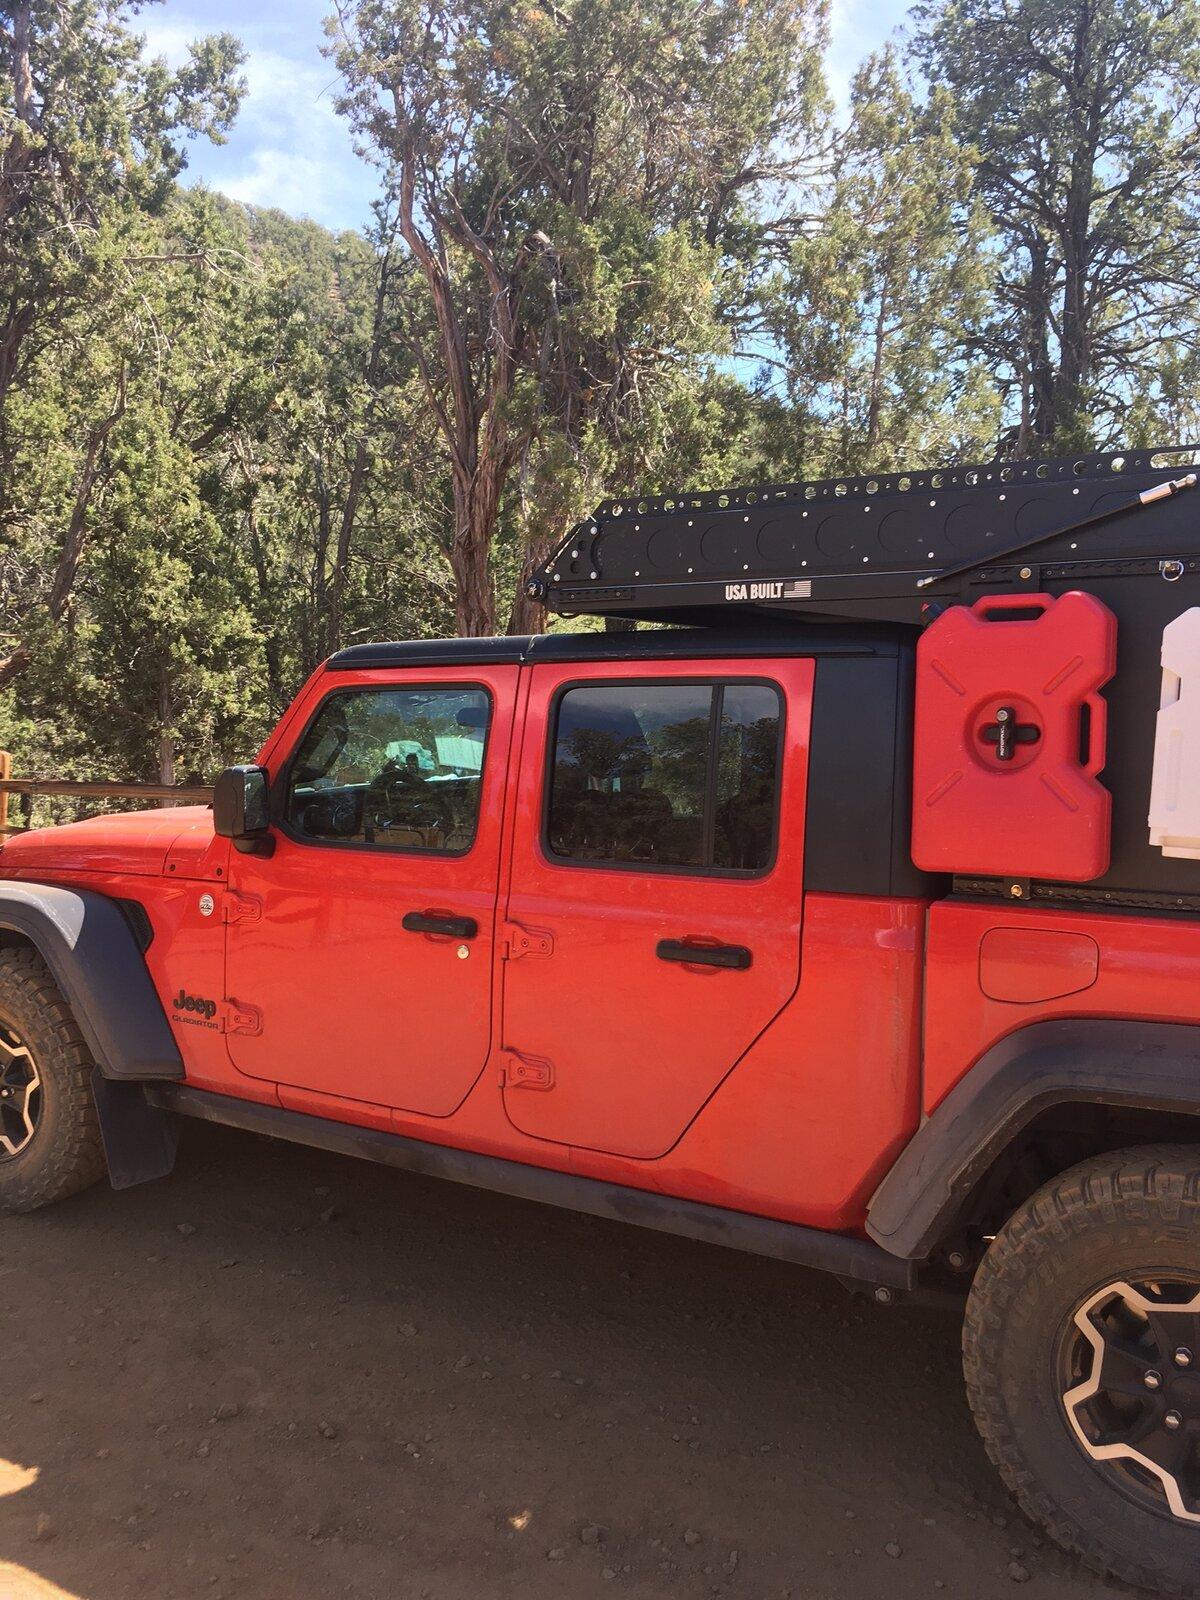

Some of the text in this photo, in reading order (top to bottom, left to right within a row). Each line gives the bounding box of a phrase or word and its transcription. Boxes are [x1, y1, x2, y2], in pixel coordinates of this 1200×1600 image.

[725, 582, 784, 601] USA BUILT
[173, 989, 217, 1020] Jeep
[172, 1014, 219, 1029] GLADIATOR
